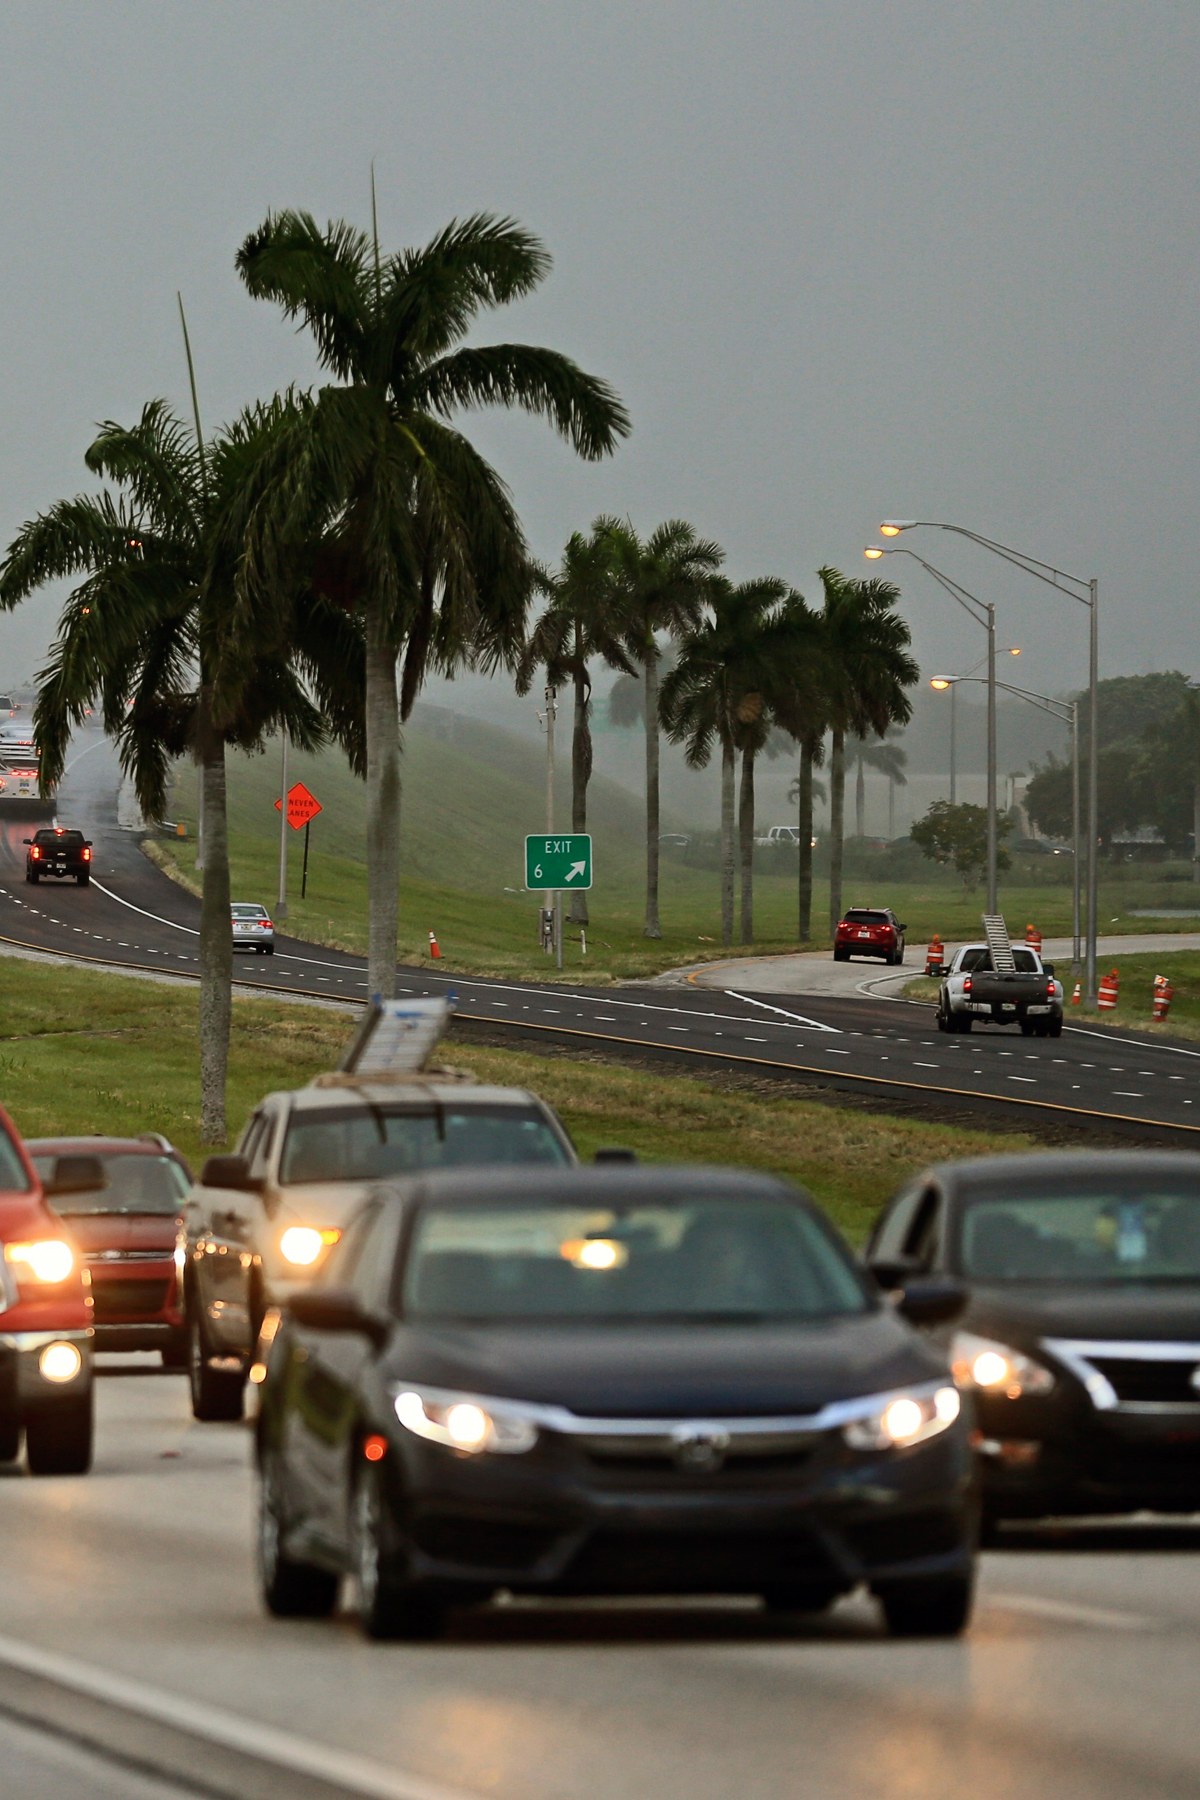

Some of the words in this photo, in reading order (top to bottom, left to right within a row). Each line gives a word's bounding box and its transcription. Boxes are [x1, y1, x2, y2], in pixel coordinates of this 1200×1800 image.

[289, 799, 314, 807] NEVEN
[288, 810, 310, 818] ANES
[545, 841, 572, 854] EXIT
[534, 864, 543, 878] 6
